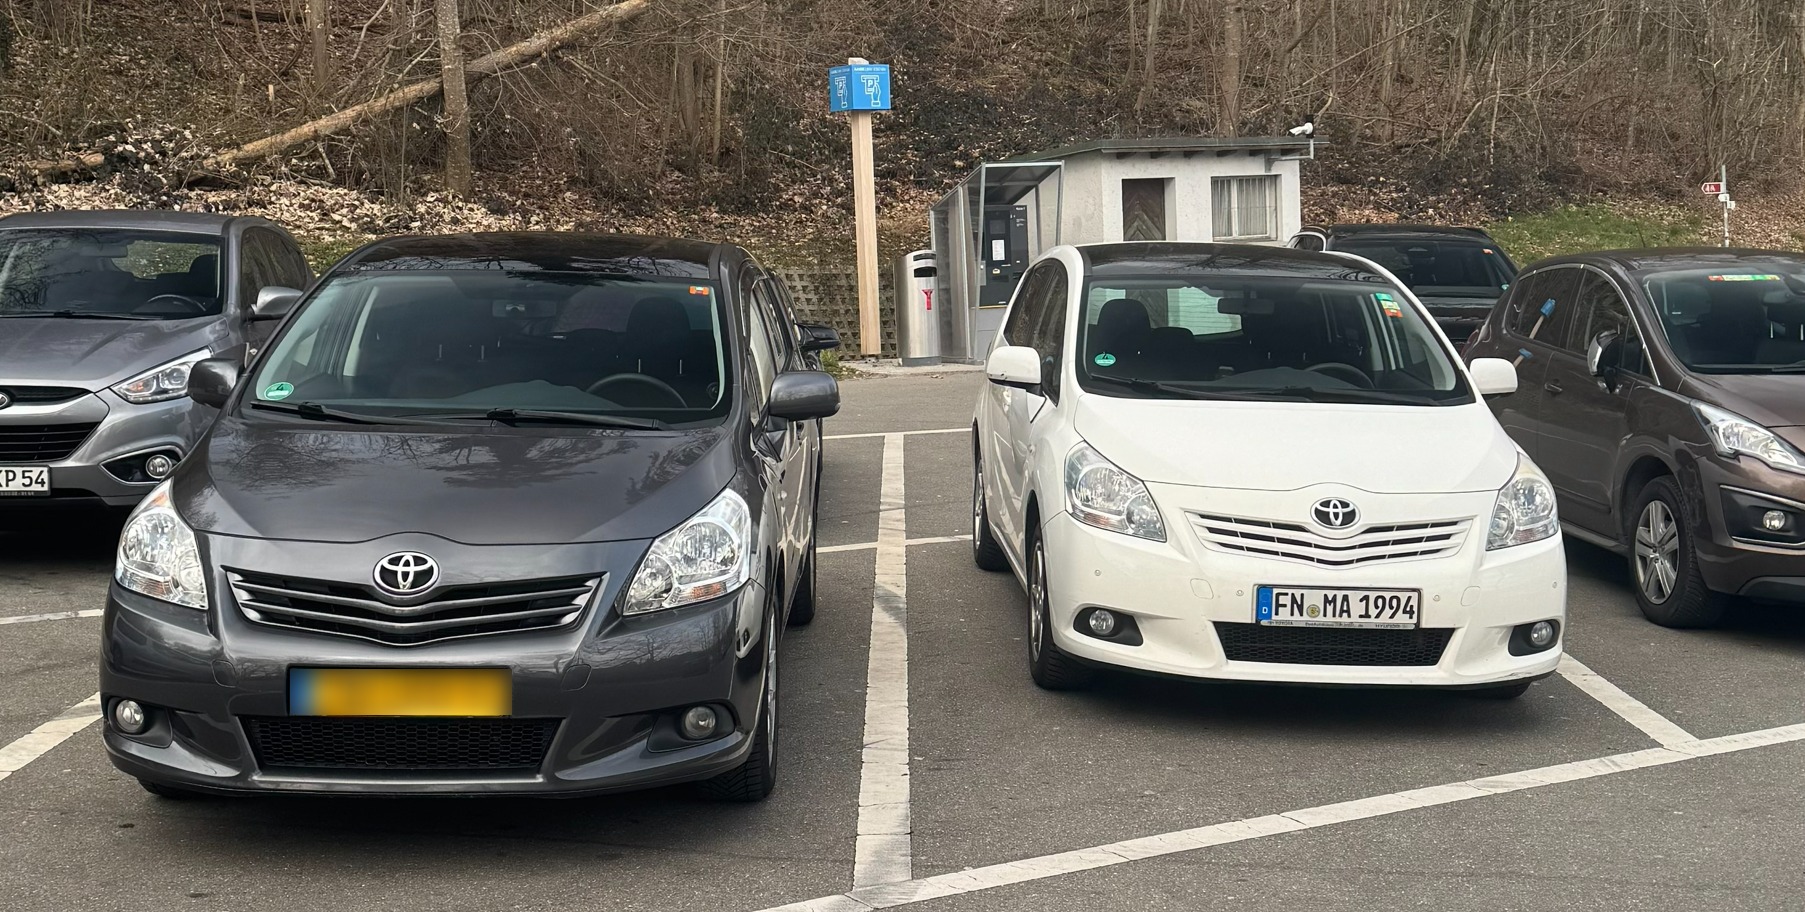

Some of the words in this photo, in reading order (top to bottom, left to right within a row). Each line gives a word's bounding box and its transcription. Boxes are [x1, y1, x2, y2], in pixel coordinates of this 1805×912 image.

[0, 470, 17, 488] P
[22, 470, 46, 488] 54
[1262, 606, 1268, 614] D
[1274, 592, 1305, 617] FN
[1322, 593, 1352, 619] MA
[1358, 594, 1415, 620] 1994
